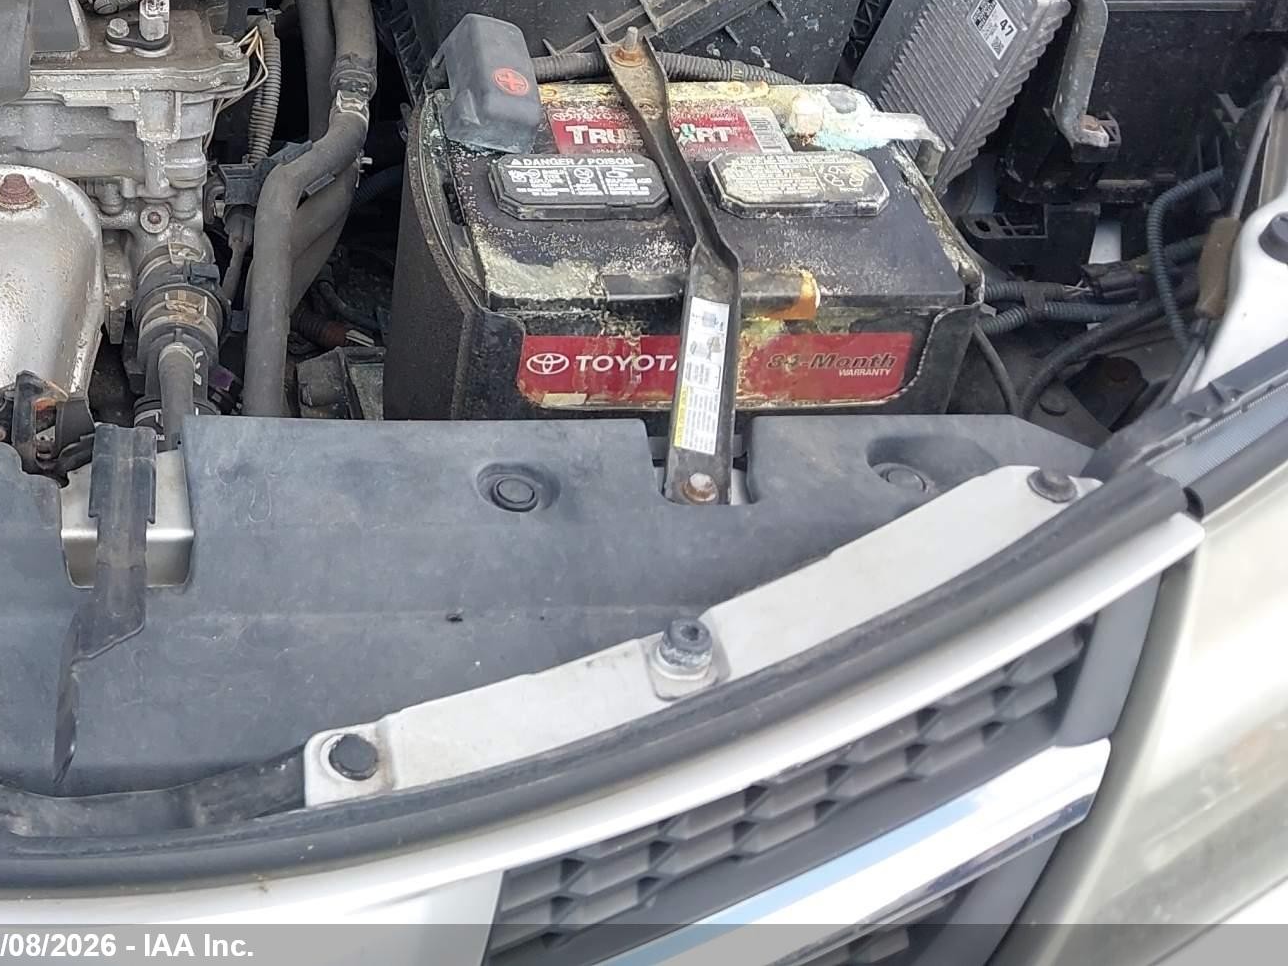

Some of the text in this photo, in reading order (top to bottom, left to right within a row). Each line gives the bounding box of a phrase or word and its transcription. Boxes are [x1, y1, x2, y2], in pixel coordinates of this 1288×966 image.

[999, 19, 1015, 36] 47
[522, 158, 575, 166] DANGER
[587, 157, 634, 165] POISON
[838, 368, 892, 377] WARRANTY
